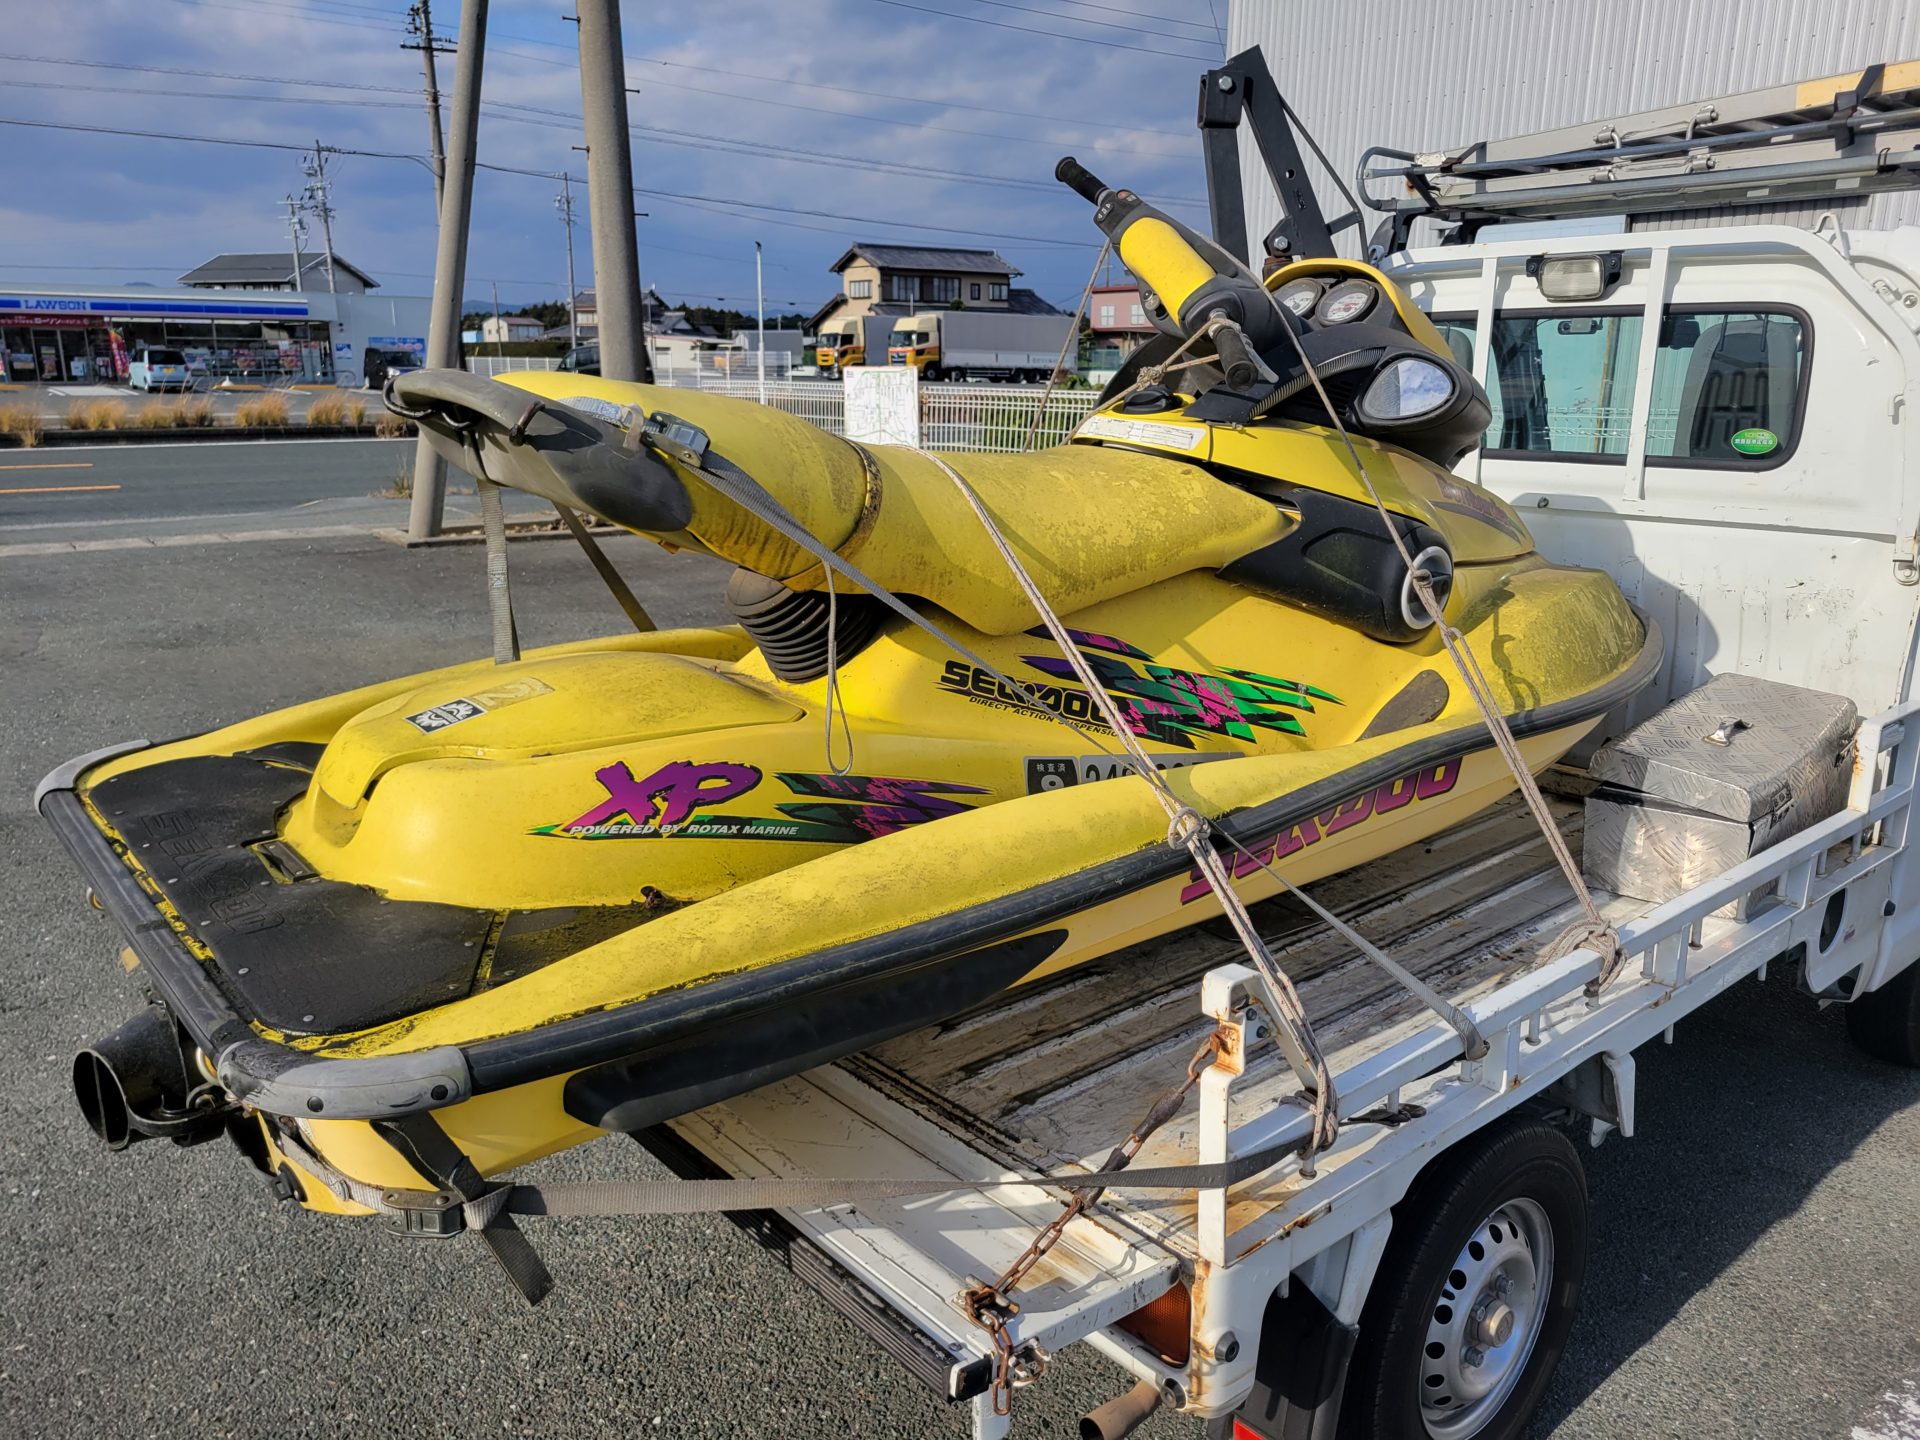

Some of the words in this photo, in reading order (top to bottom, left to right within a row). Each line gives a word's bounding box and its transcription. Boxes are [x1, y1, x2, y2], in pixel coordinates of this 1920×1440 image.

[23, 300, 87, 311] LAWSON
[969, 696, 1011, 712] DIRECT
[1012, 708, 1055, 722] ACTION
[1058, 716, 1127, 737] SPENSIO
[1036, 763, 1066, 773] 検査済
[561, 761, 763, 831] XP
[569, 824, 656, 835] POWERED
[659, 825, 685, 834] BY
[687, 825, 740, 835] ROTAX
[742, 825, 799, 835] MARINE
